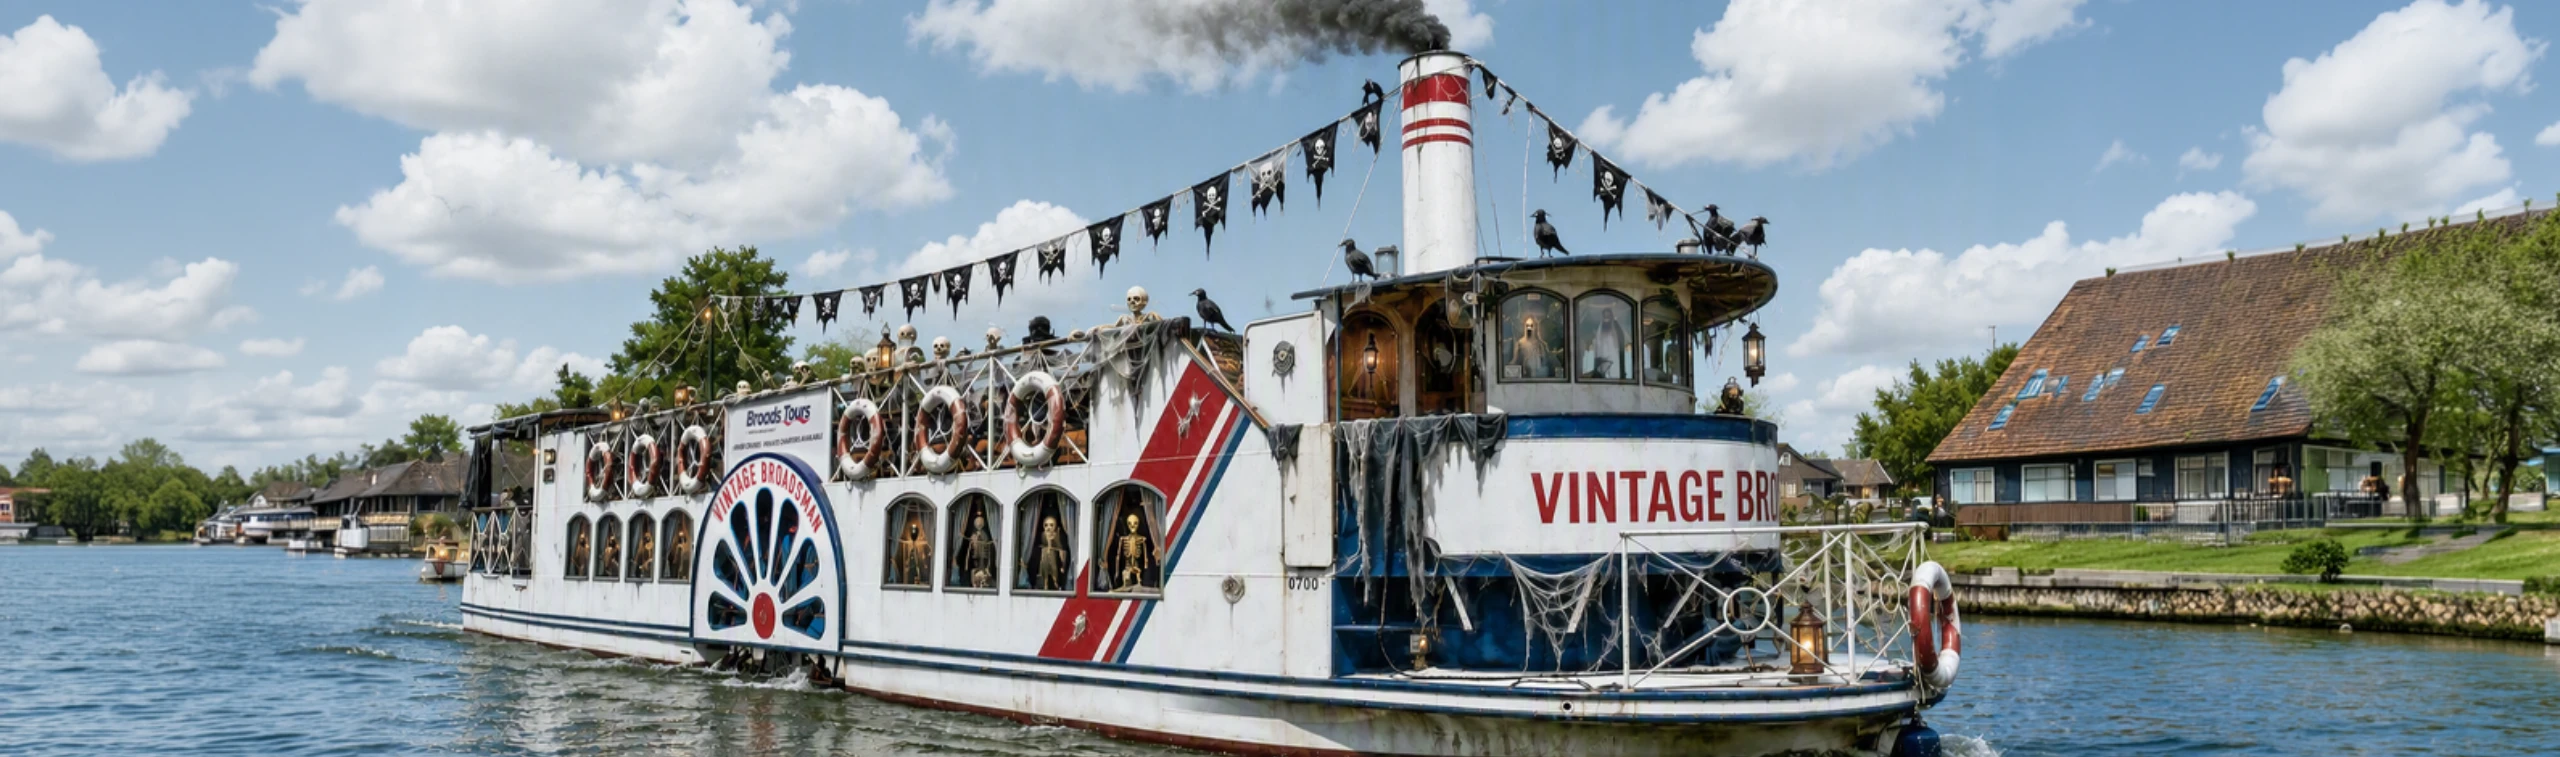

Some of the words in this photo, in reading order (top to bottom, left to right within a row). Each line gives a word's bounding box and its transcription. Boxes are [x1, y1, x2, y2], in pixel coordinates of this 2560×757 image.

[746, 406, 781, 427] Broads
[784, 404, 811, 422] Tours
[713, 463, 757, 522] VINTAGE
[761, 461, 822, 533] BROADSMAN
[1531, 470, 1726, 523] VINTAGE
[1289, 577, 1319, 590] 0700
